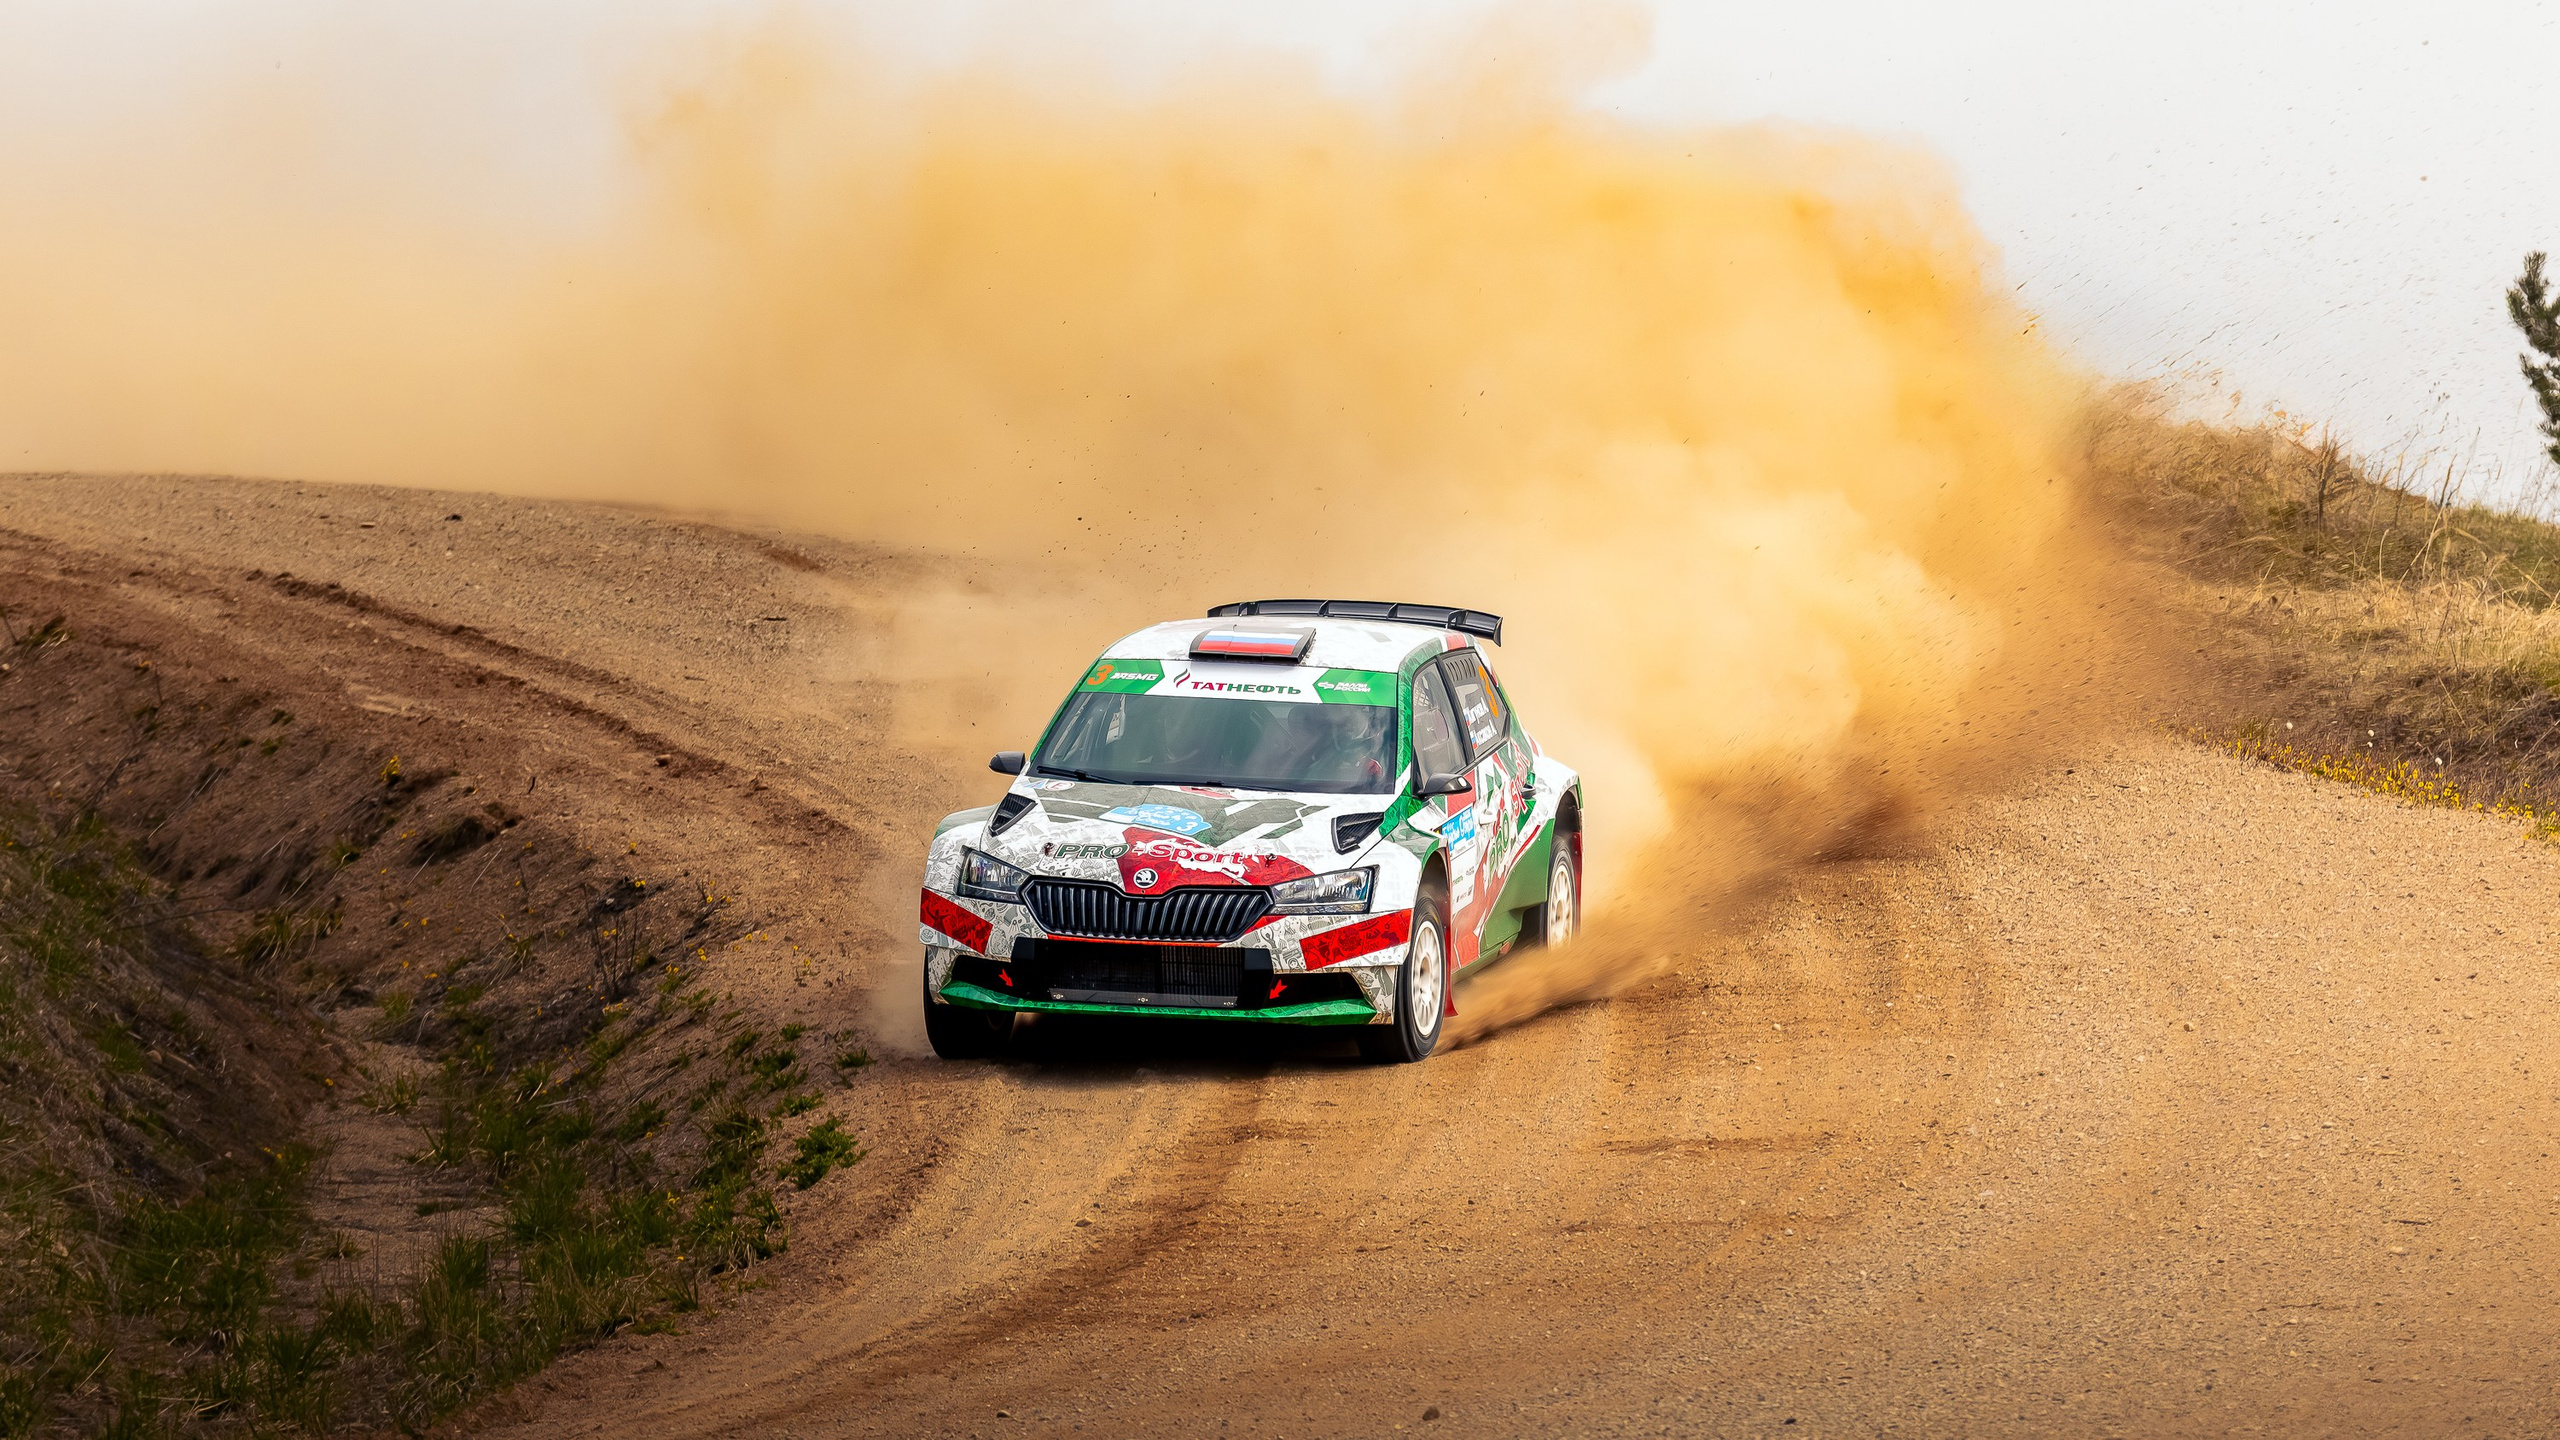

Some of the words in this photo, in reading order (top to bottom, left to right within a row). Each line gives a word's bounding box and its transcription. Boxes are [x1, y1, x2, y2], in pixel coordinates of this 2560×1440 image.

[1087, 664, 1114, 685] 3
[1191, 681, 1301, 695] ТАТНЕФТЬ
[1478, 665, 1499, 718] 3
[1177, 821, 1198, 832] 3
[1055, 843, 1129, 859] PRO
[1150, 844, 1244, 865] Sport
